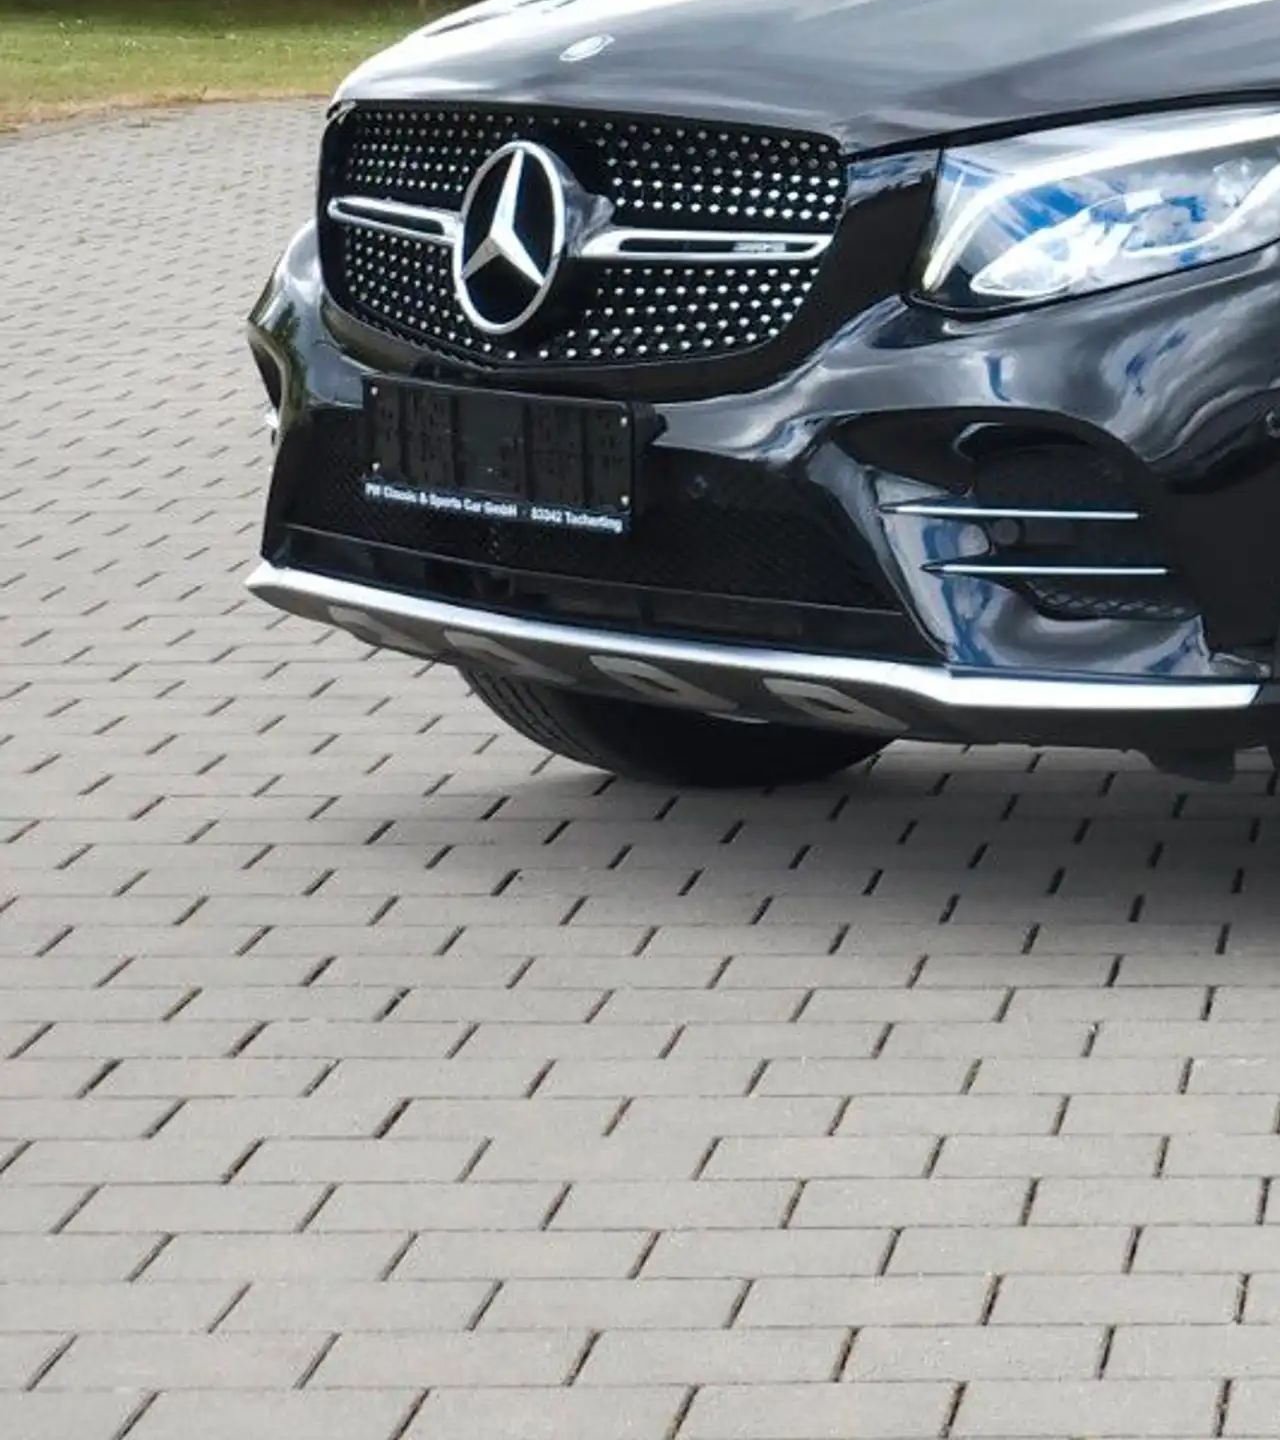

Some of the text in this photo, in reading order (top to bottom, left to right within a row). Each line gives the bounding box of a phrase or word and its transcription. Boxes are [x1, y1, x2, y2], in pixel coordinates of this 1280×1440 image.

[419, 491, 429, 505] &
[429, 493, 462, 510] Sports
[483, 501, 518, 518] GmbH
